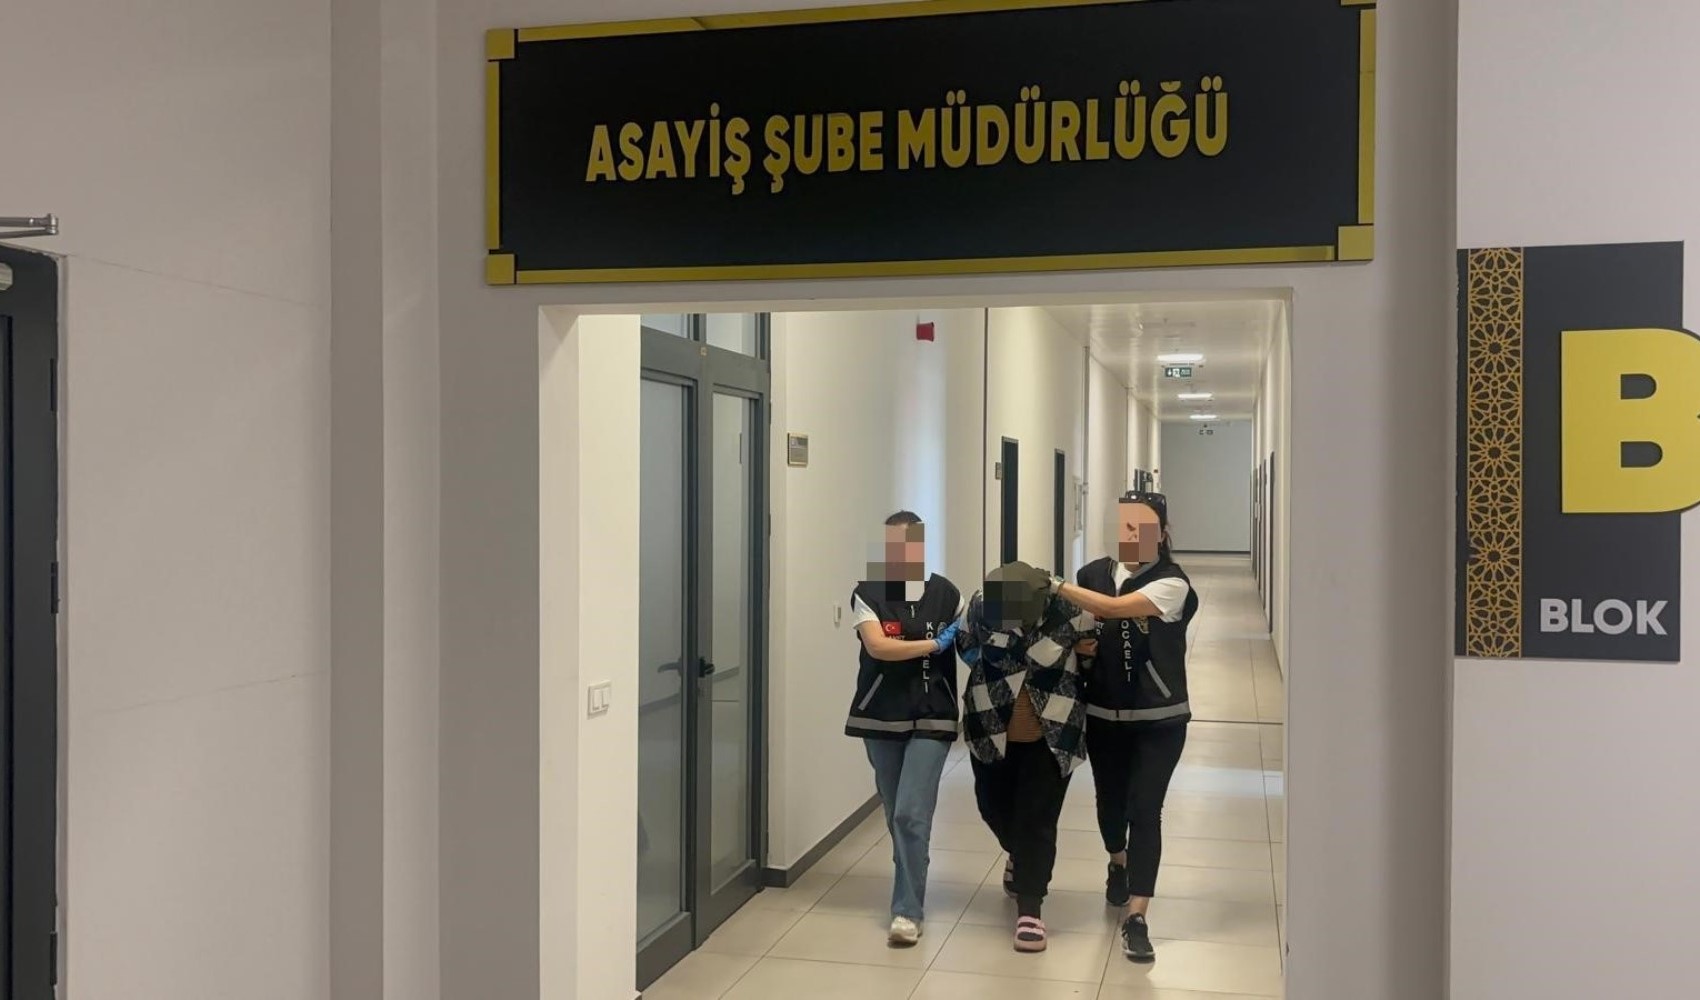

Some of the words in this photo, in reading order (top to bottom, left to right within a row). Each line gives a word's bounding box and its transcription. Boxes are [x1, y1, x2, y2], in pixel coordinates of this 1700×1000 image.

[585, 102, 751, 195] ASAYİŞ
[764, 110, 883, 194] ŞUBE
[897, 75, 1229, 170] MÜDÜRLÜĞÜ
[1561, 327, 1700, 514] B
[1540, 597, 1669, 636] BLOK
